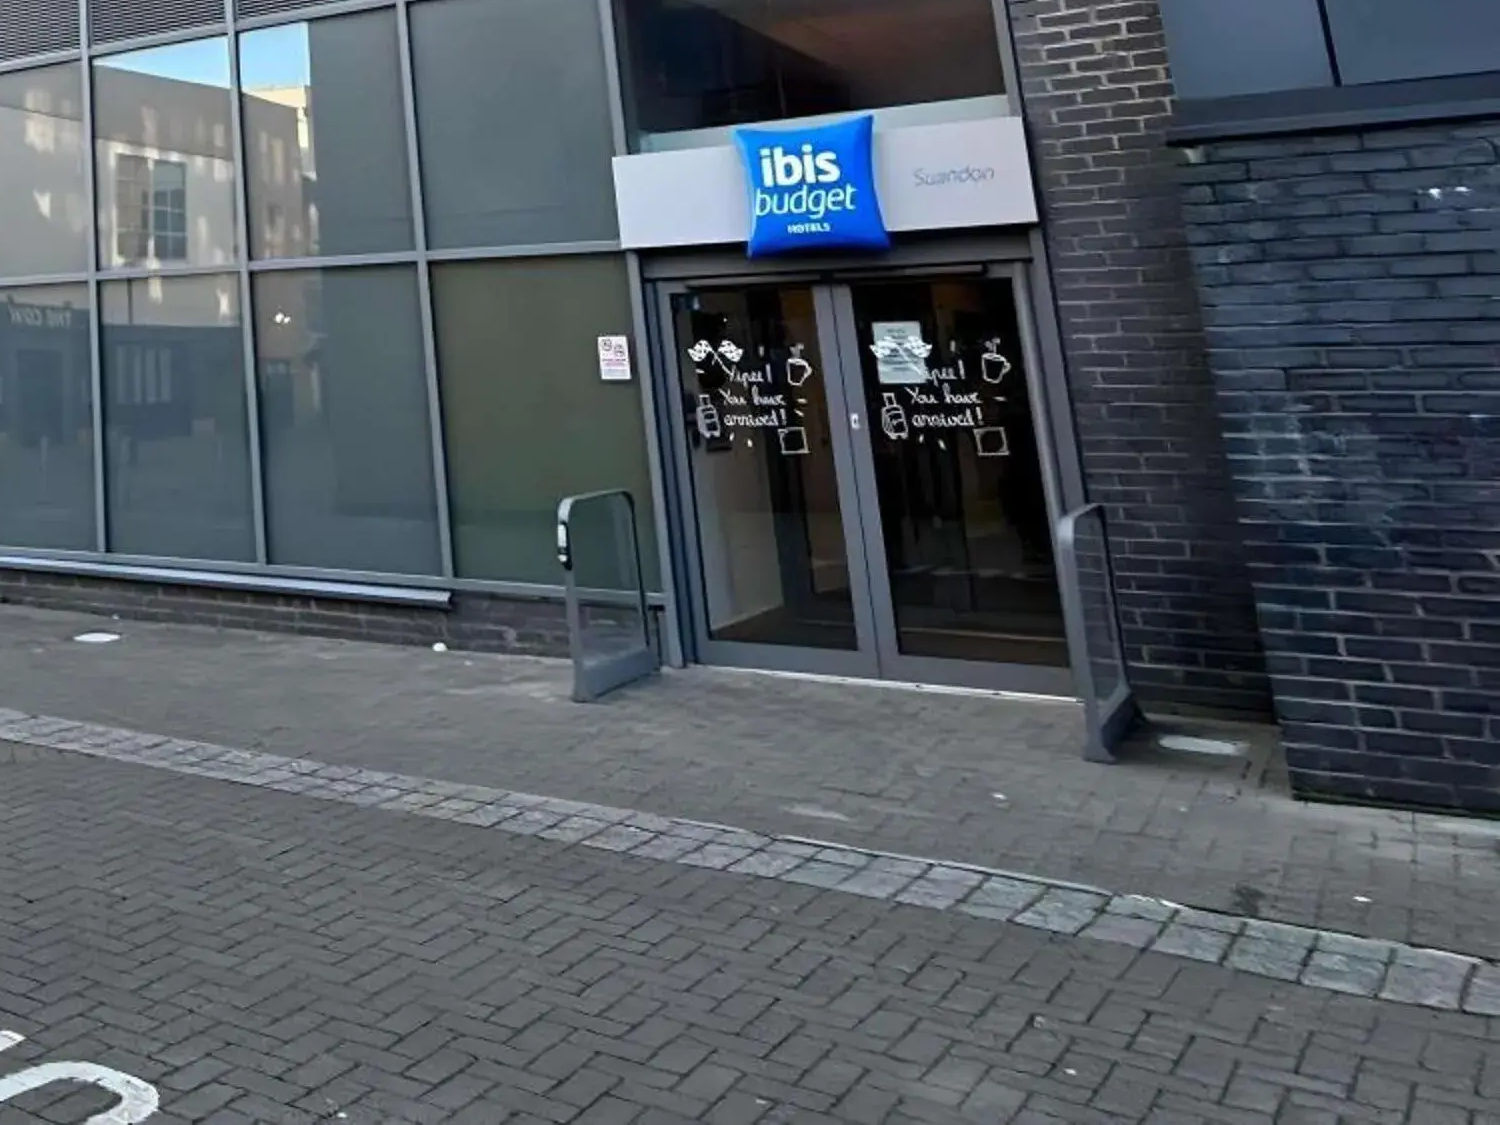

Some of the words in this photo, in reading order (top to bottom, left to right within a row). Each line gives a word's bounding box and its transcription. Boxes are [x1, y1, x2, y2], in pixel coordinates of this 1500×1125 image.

[760, 143, 841, 188] ibis
[755, 183, 858, 219] budget
[787, 222, 831, 234] HOTELS
[718, 387, 748, 406] You
[751, 384, 787, 406] have
[904, 385, 940, 405] You
[941, 382, 983, 404] have
[723, 408, 788, 427] arrived!
[911, 406, 985, 428] arrived!
